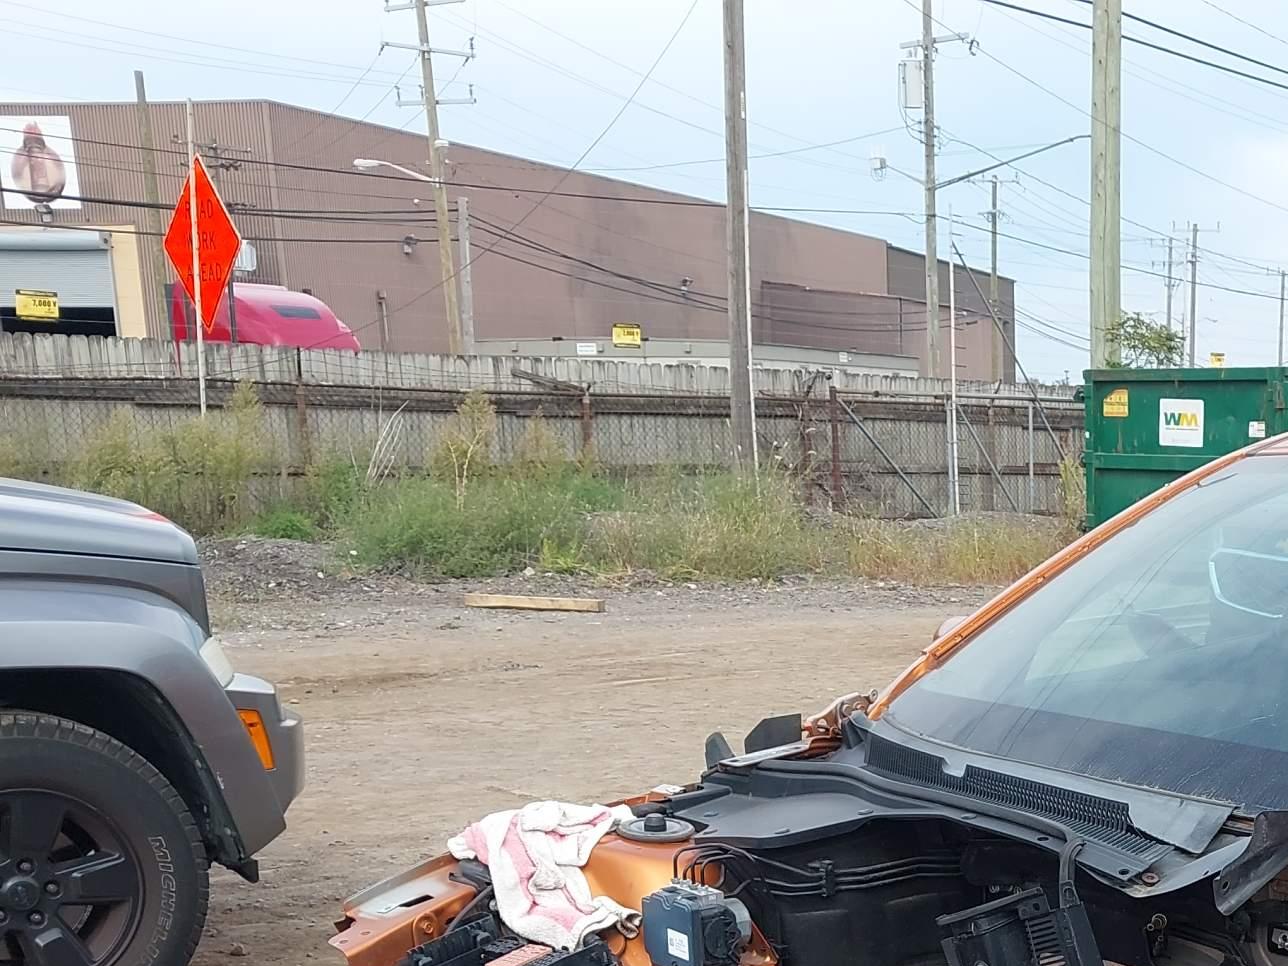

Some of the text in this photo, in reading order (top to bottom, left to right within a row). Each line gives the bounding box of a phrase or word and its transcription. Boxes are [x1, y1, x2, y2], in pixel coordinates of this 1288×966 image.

[184, 200, 213, 219] RAD
[187, 263, 222, 283] AEAD
[1164, 412, 1199, 426] WM
